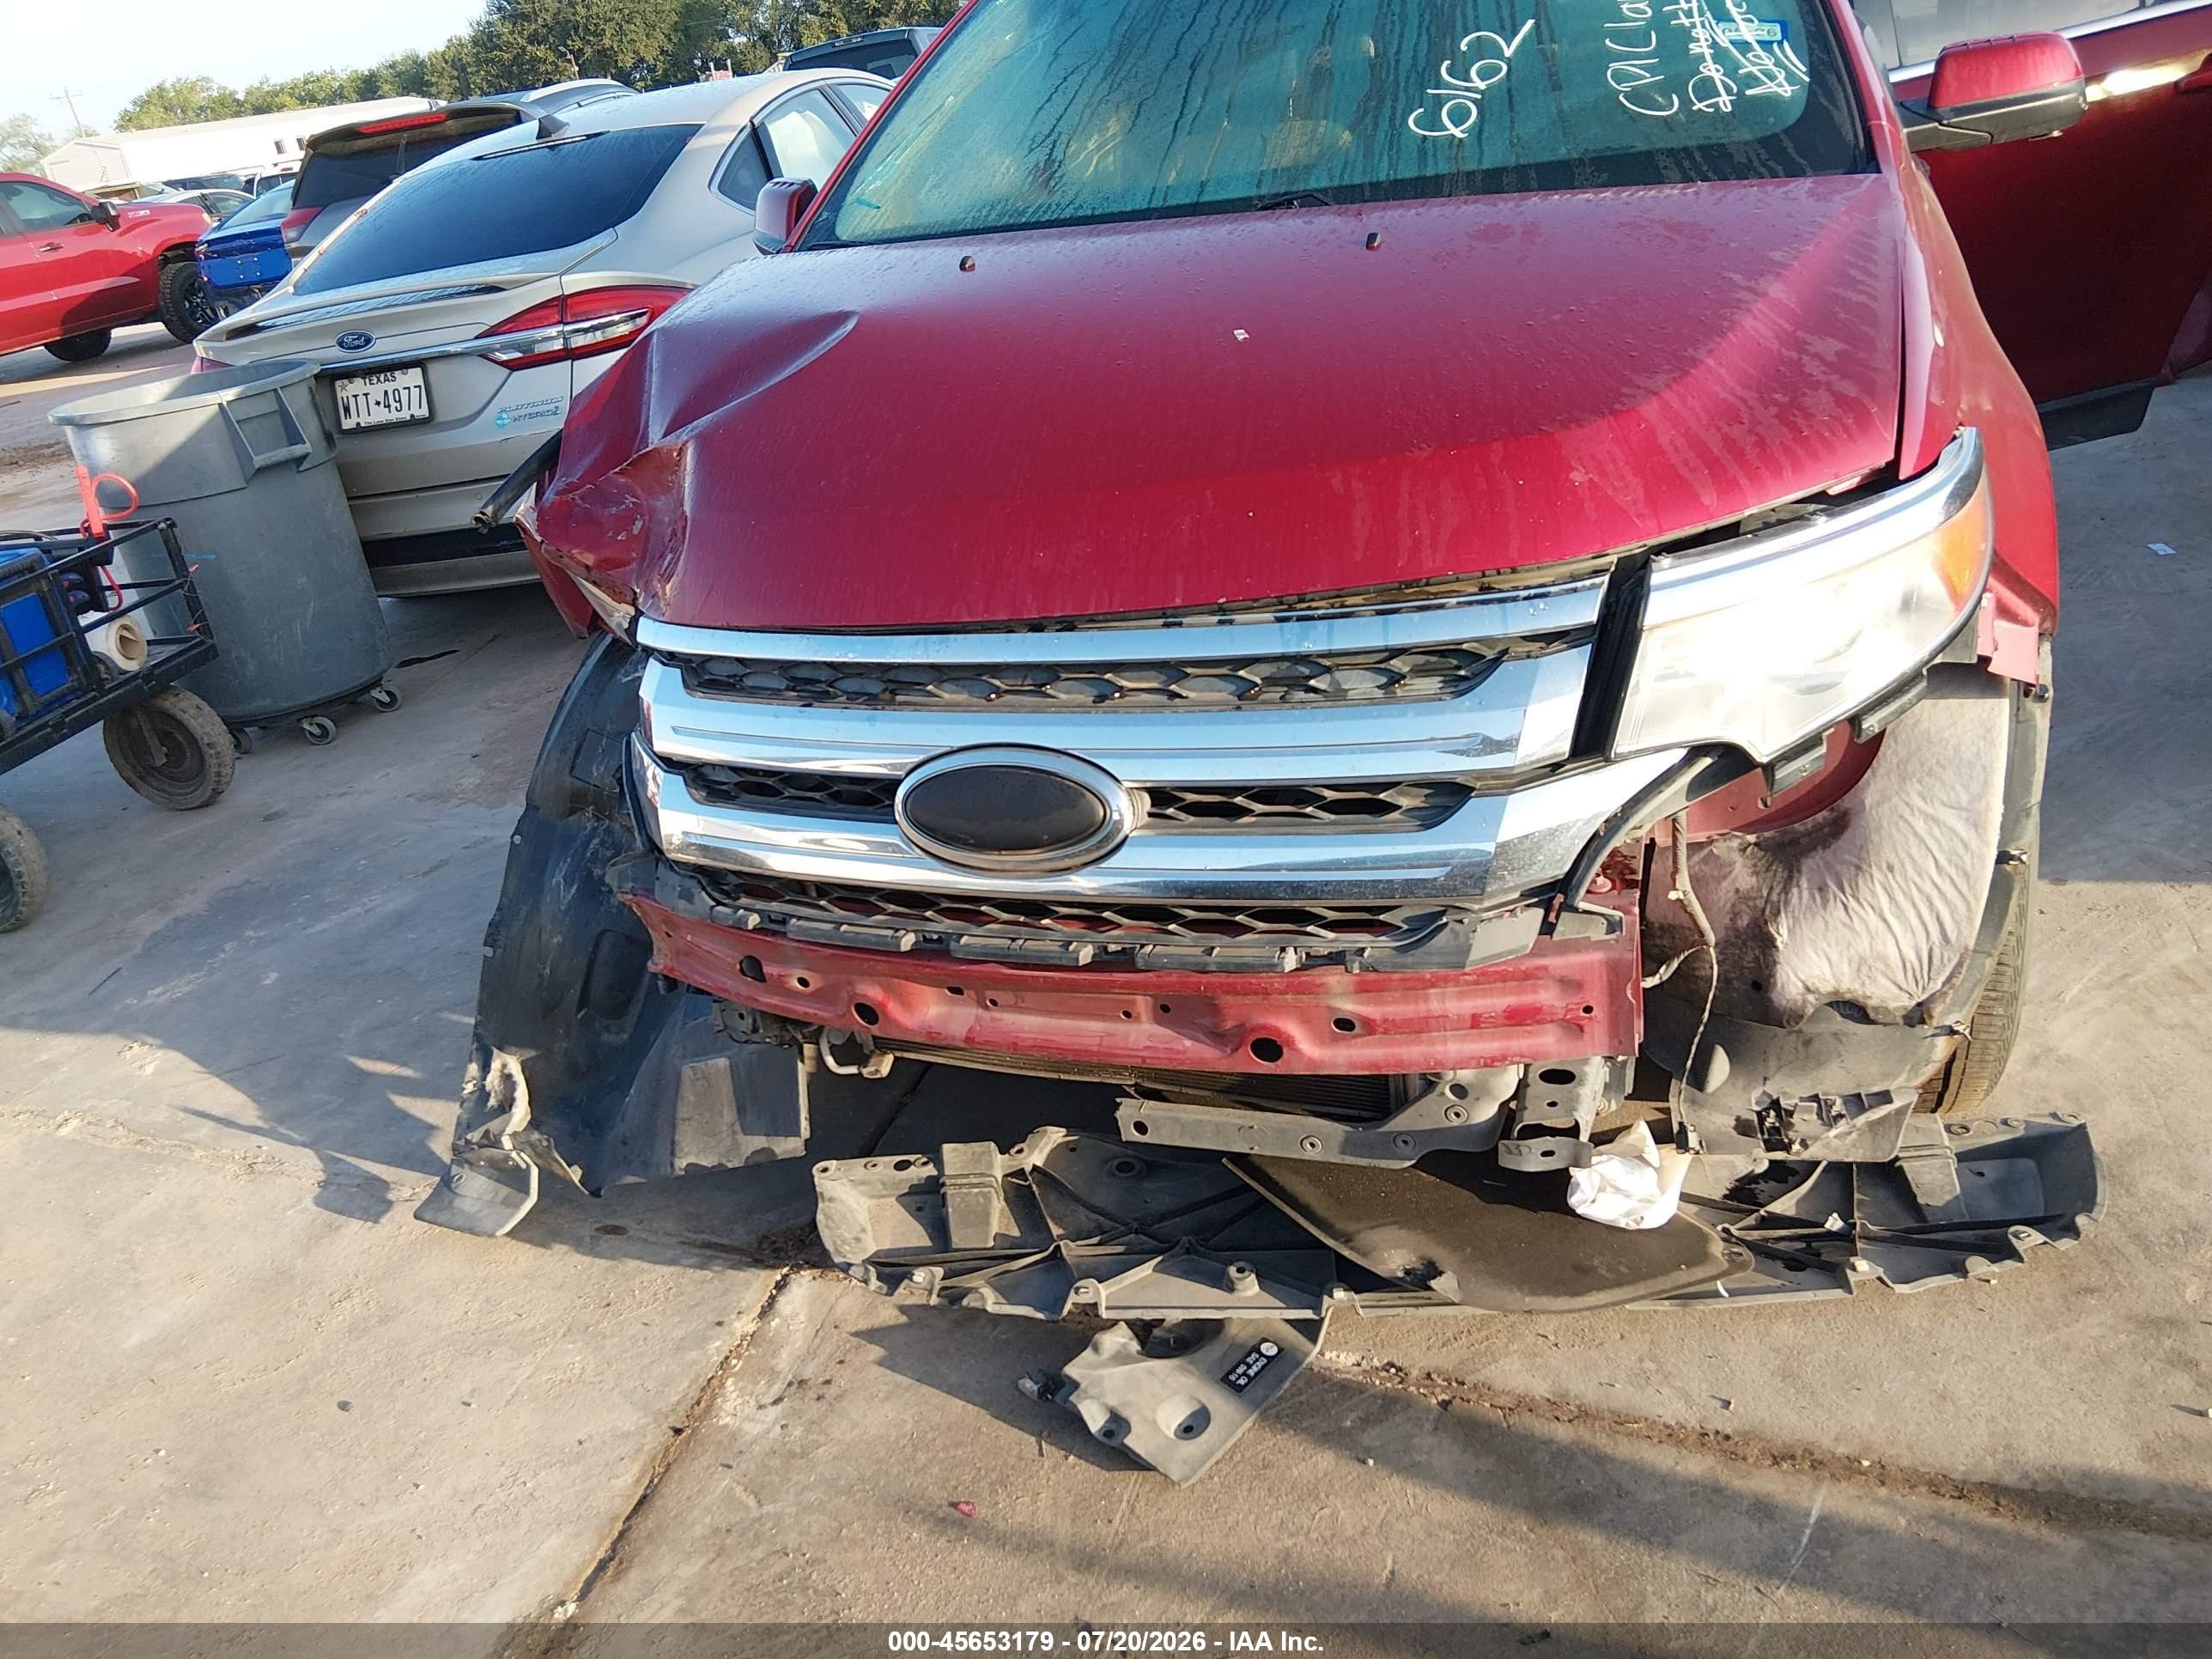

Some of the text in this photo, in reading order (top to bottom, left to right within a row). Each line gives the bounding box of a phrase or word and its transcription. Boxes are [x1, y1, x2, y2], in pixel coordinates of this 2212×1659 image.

[1407, 18, 1536, 138] 6162
[343, 335, 366, 348] Ford
[361, 372, 397, 386] TEXAS
[383, 385, 422, 414] 4977
